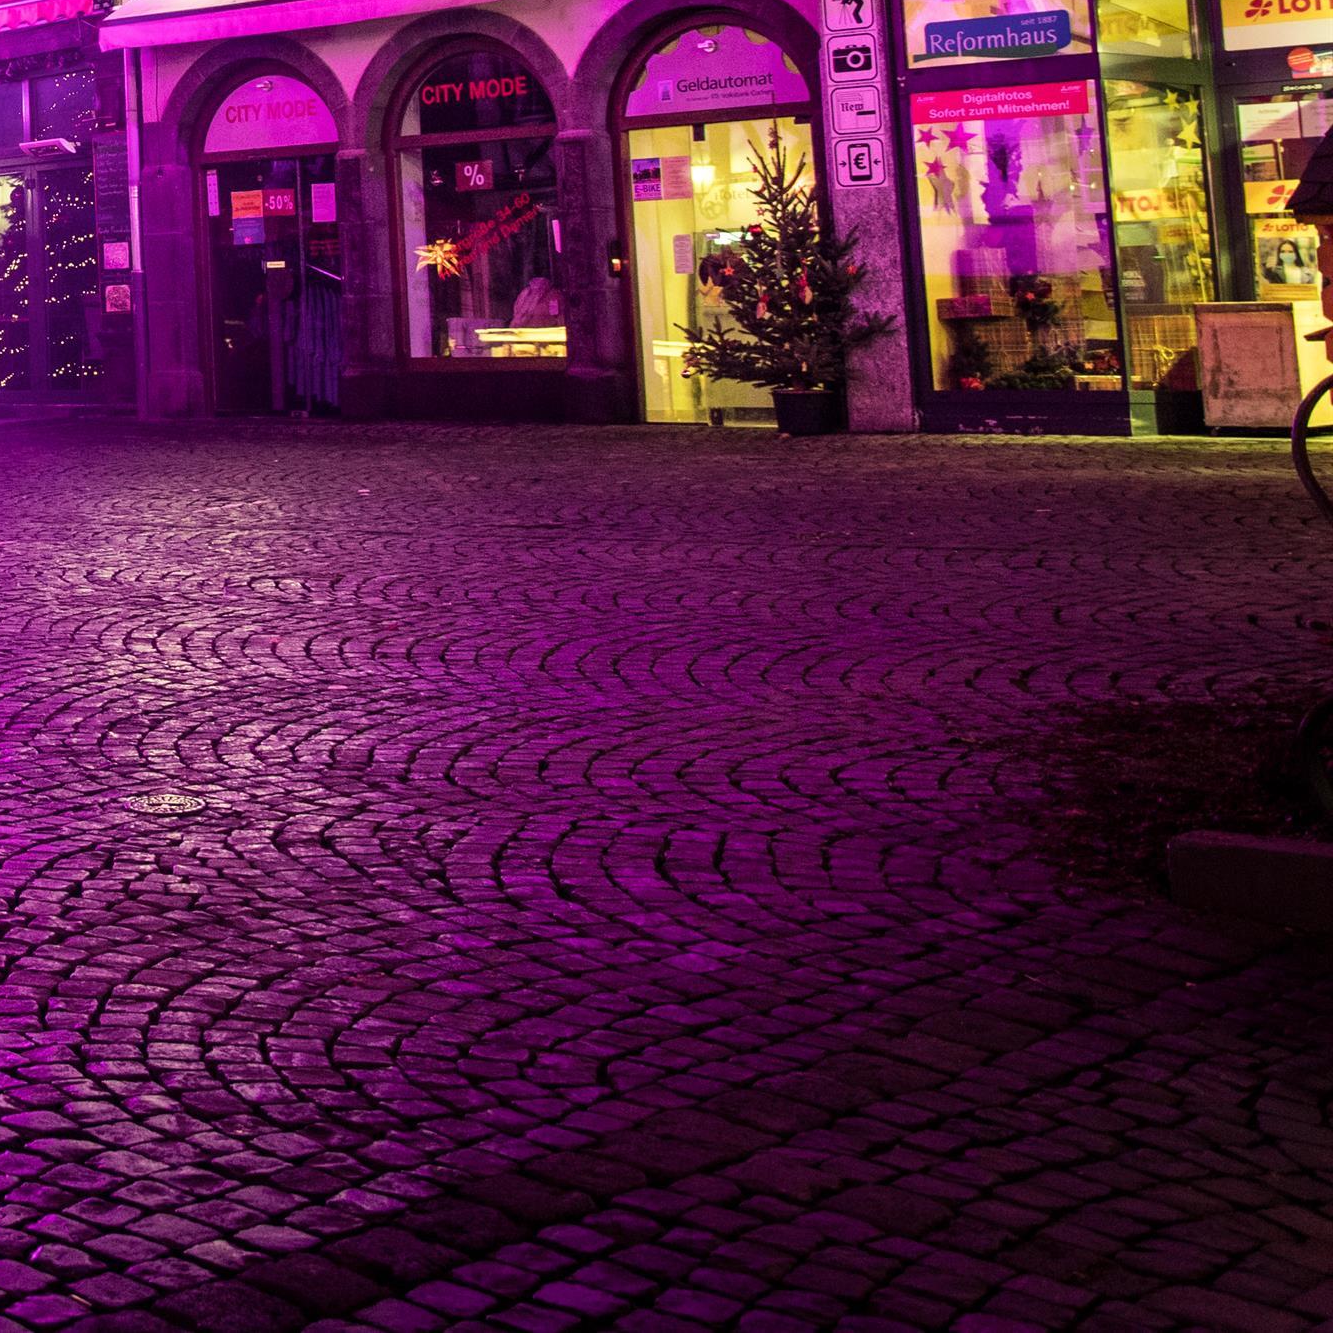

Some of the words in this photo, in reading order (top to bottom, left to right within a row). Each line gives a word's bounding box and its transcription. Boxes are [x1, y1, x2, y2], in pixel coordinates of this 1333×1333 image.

[930, 27, 1057, 56] Reformhaus
[421, 83, 465, 105] CITY
[469, 76, 528, 99] MODE
[677, 73, 773, 93] Geldautomat
[963, 90, 1032, 105] Digitalfotos
[226, 104, 262, 123] CITY
[267, 98, 317, 119] MODE
[929, 107, 965, 119] Sofort
[968, 106, 994, 116] zum
[997, 100, 1070, 114] Mitnehmen!
[464, 164, 485, 186] %
[1276, 222, 1310, 232] LOTTO
